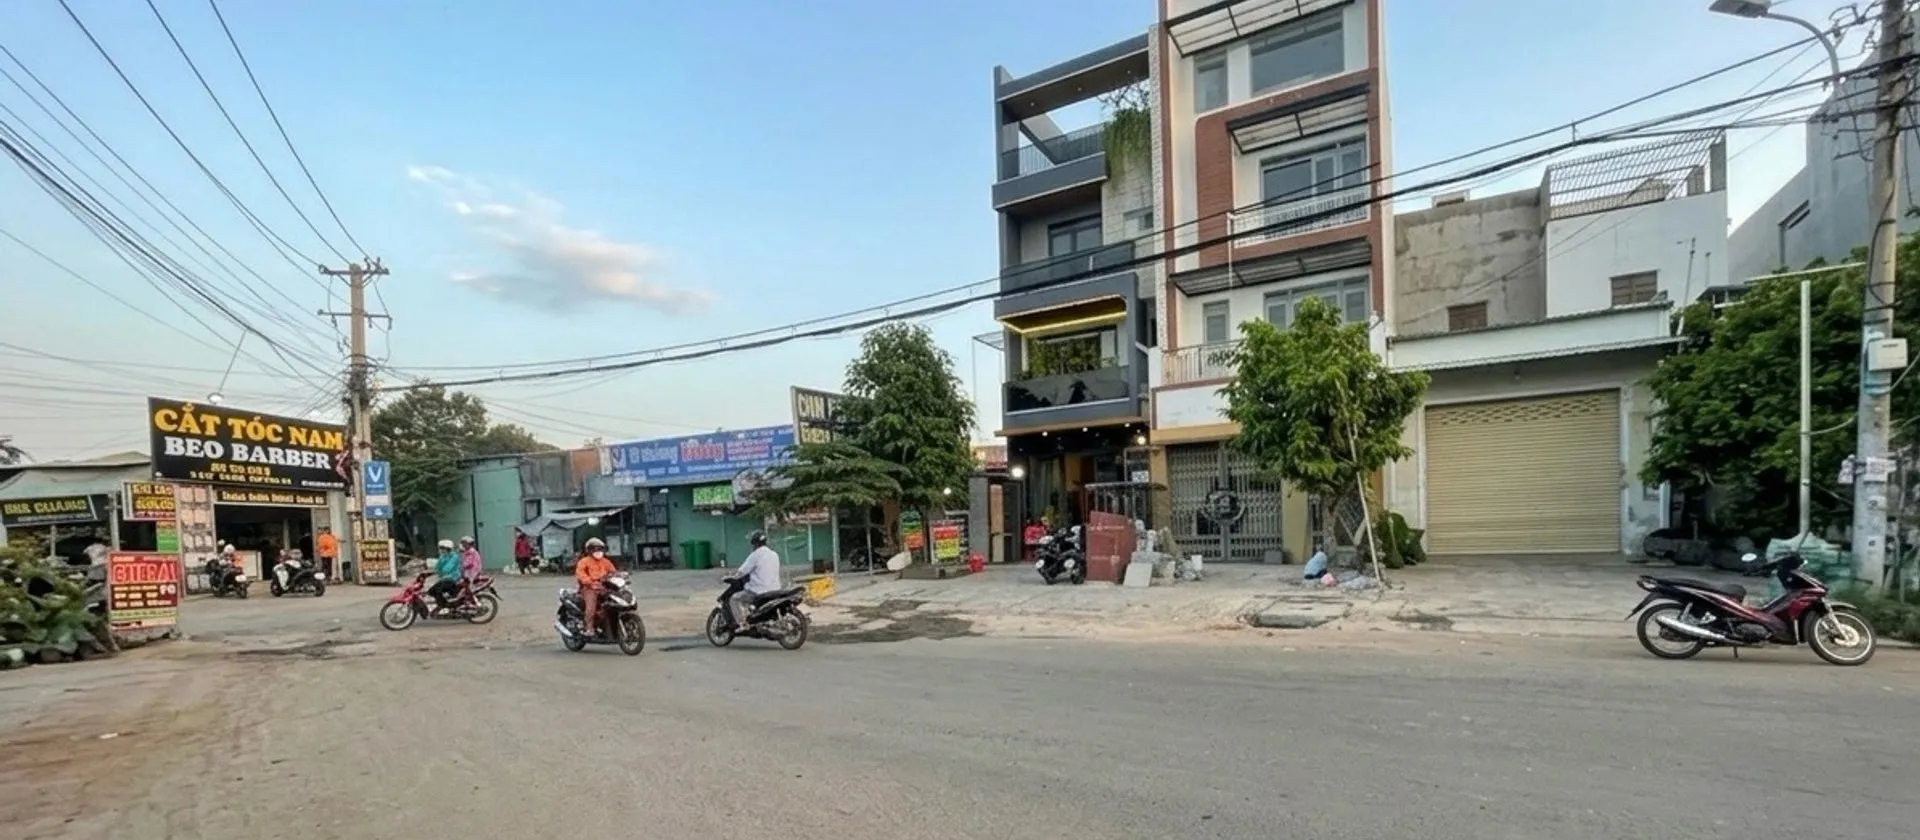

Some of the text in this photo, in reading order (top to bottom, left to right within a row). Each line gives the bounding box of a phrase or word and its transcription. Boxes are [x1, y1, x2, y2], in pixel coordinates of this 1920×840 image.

[154, 403, 344, 450] CẮT TÓC NAM
[164, 436, 224, 459] BEO
[231, 443, 331, 469] BARBER
